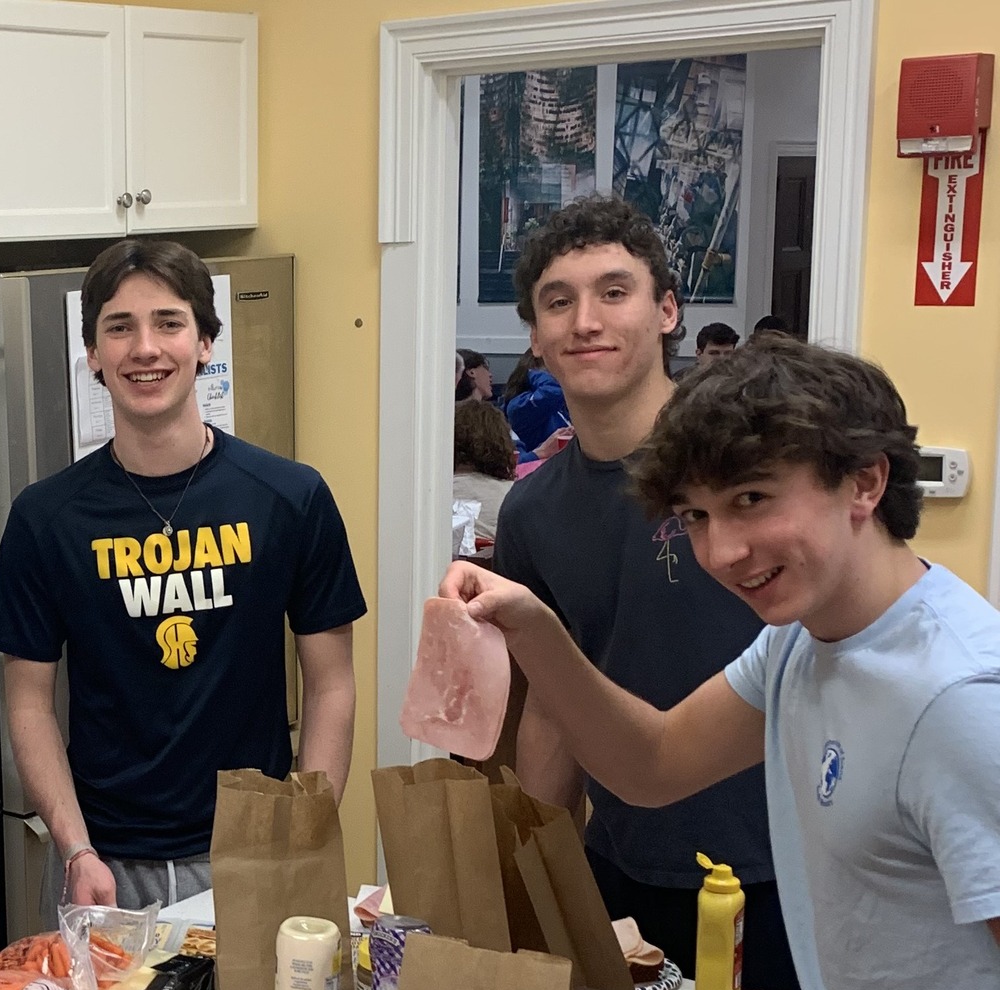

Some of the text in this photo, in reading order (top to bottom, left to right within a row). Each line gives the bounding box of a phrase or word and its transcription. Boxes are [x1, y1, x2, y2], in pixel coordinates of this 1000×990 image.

[933, 154, 974, 170] FIRE
[940, 175, 958, 290] EXTINGUISHER
[91, 522, 252, 579] TROJAN
[118, 568, 234, 618] WALL
